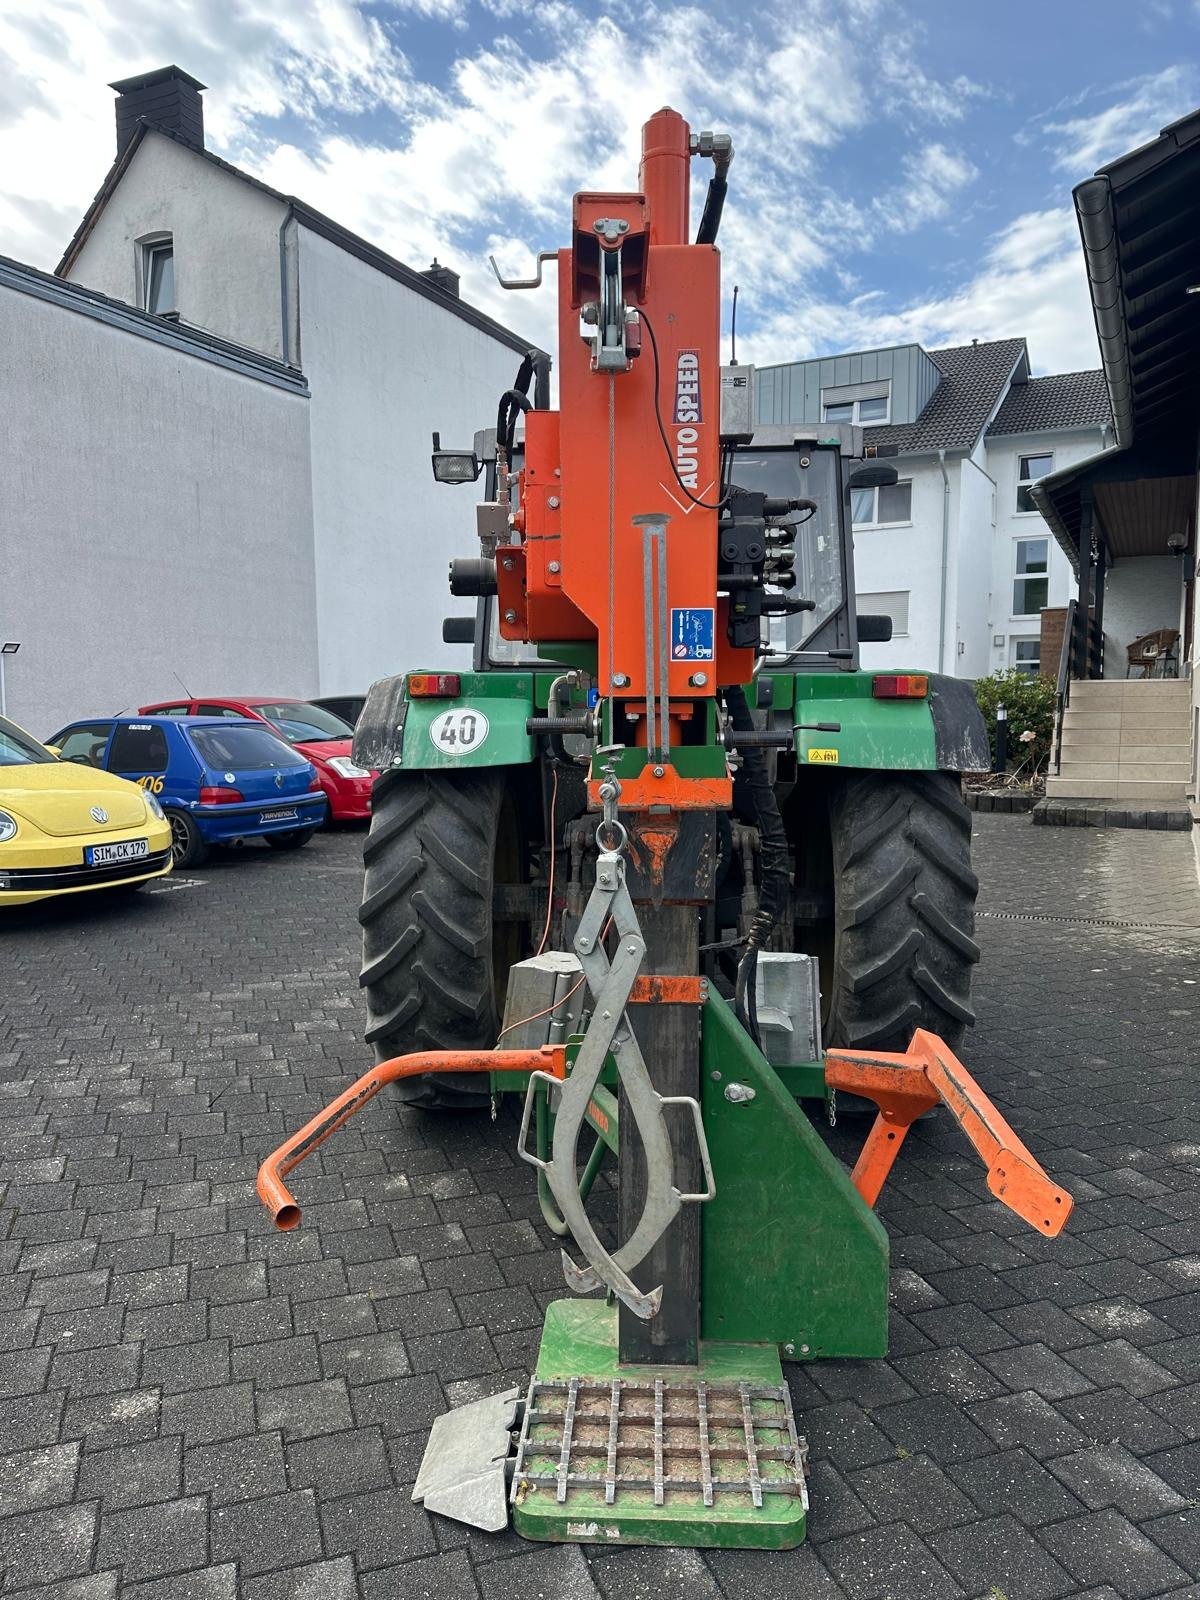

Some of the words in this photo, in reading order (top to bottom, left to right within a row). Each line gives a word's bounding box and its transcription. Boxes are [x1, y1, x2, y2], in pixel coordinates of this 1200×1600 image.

[440, 715, 476, 745] 40
[94, 847, 113, 862] SIM
[117, 844, 129, 858] CK
[130, 841, 146, 856] 179
